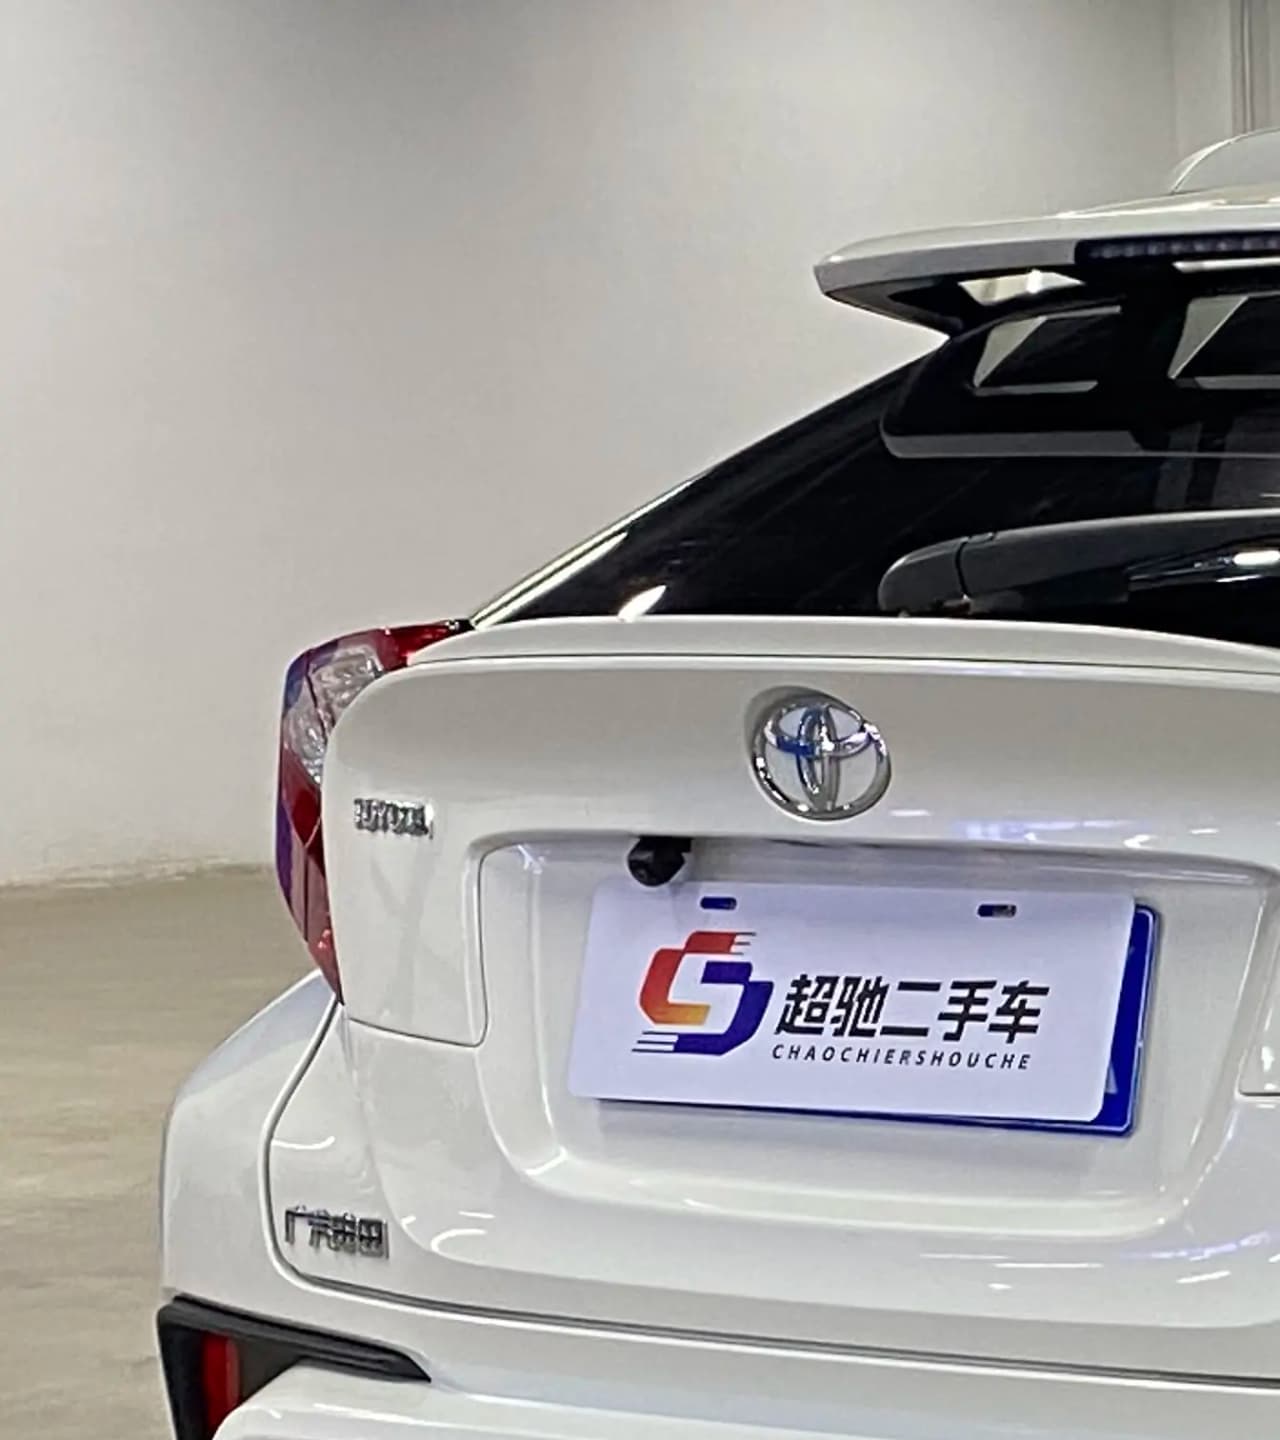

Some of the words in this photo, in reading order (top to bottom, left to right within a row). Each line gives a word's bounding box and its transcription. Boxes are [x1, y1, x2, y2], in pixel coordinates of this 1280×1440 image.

[774, 973, 1050, 1044] 超驰二手车
[772, 1044, 1031, 1070] CHAOCHIERSHOUCHE
